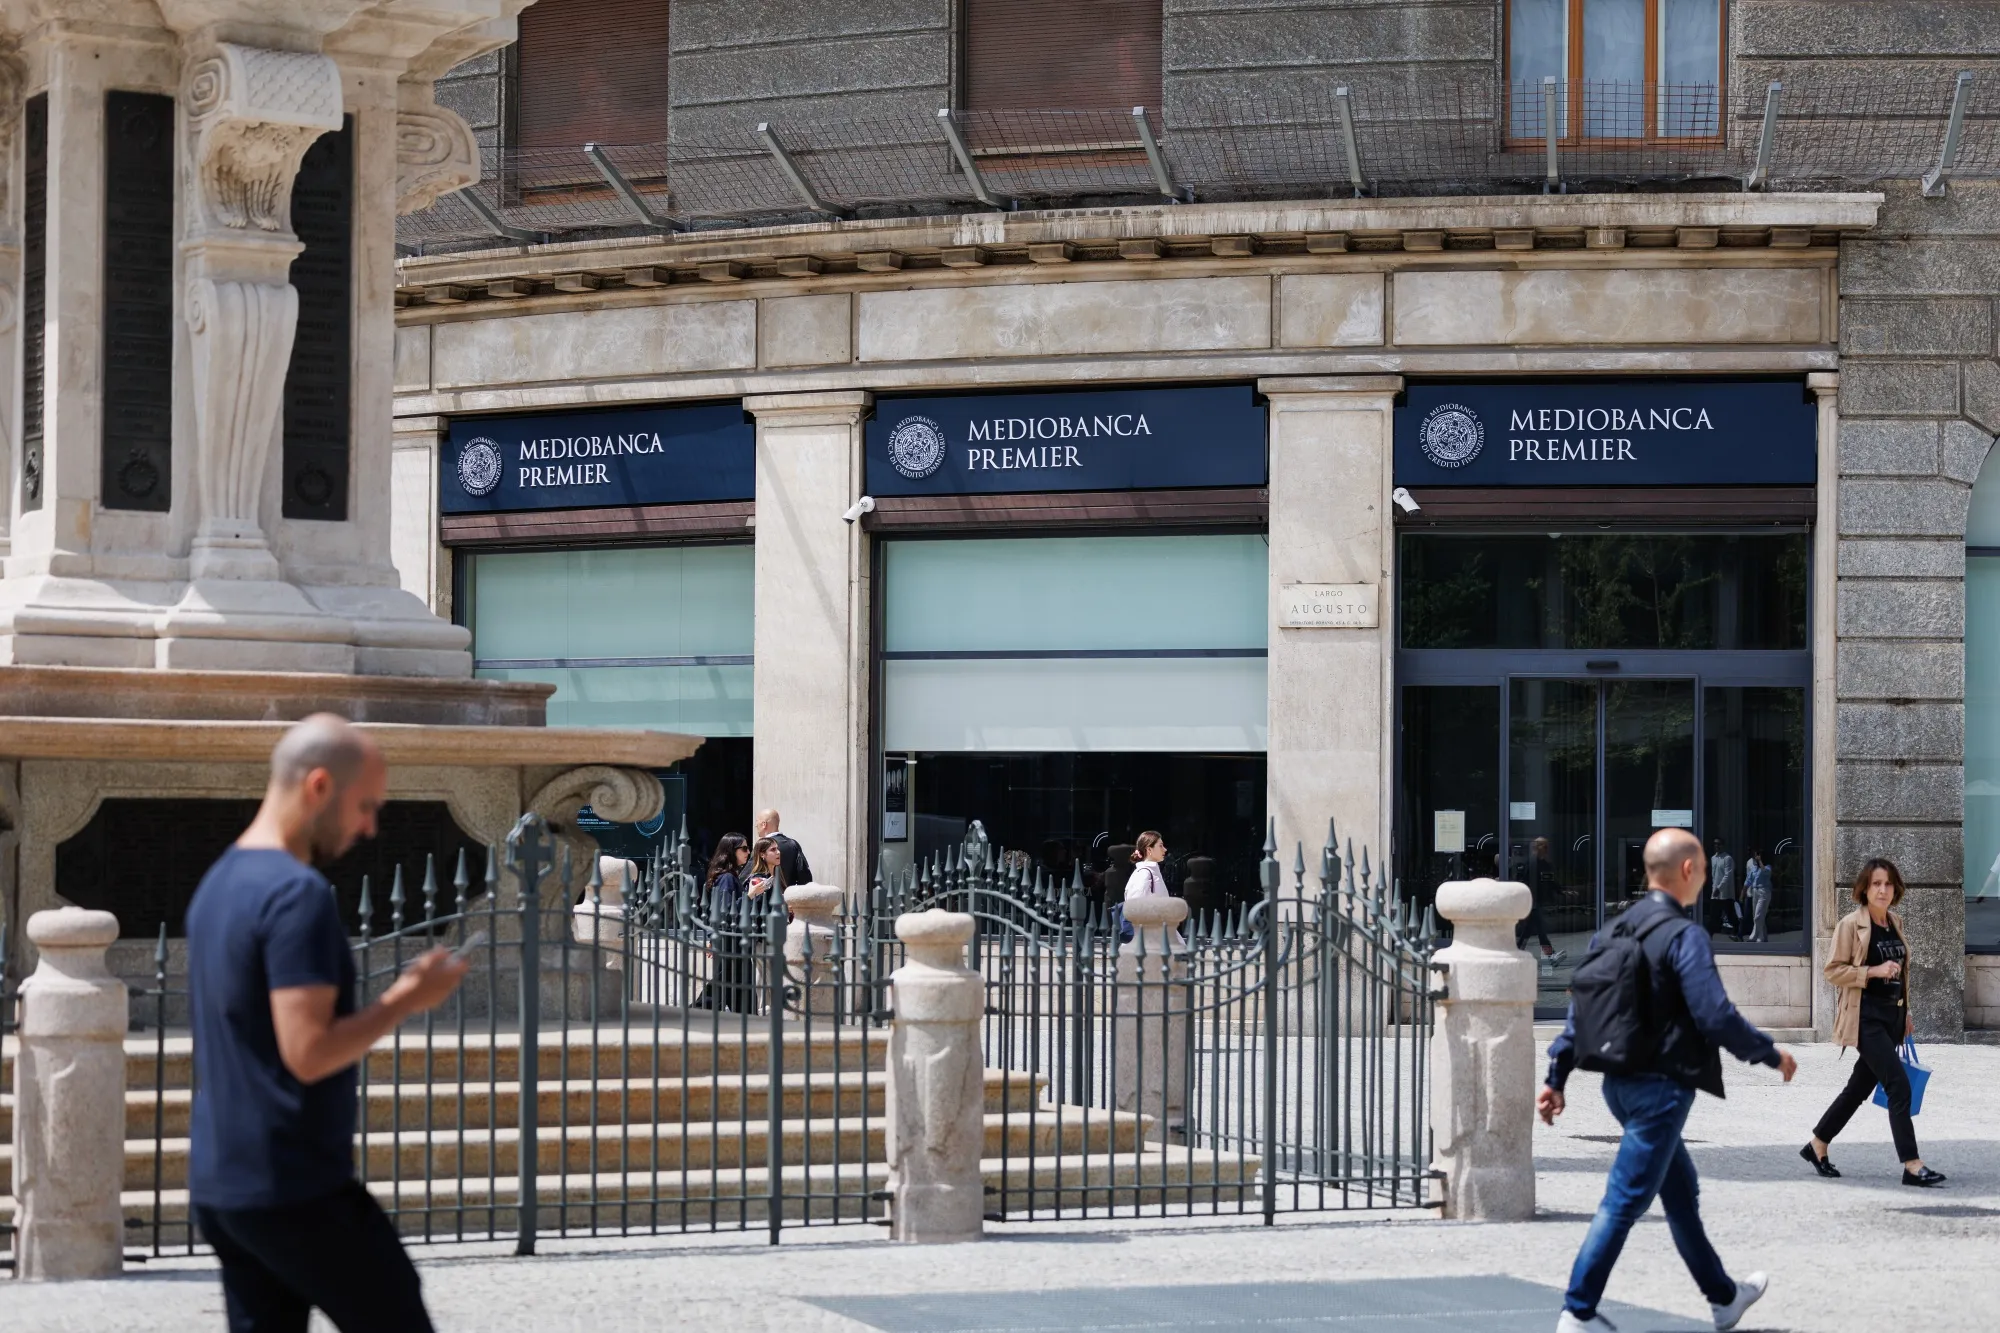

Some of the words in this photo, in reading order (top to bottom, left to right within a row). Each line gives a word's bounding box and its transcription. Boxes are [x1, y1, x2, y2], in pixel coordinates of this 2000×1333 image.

[896, 415, 939, 431] MEDIOBANCA
[1430, 403, 1478, 421] MEDIOBANCA
[1509, 407, 1714, 431] MEDIOBANCA
[967, 413, 1152, 442] MEDIOBANCA
[1419, 417, 1431, 443] BANCA
[519, 432, 665, 460] MEDIOBANCA
[888, 430, 897, 455] BANCA
[1421, 444, 1430, 453] DI
[1461, 421, 1485, 466] FINANZIARIO
[1509, 438, 1637, 461] PREMIER
[890, 456, 897, 465] DI
[967, 445, 1083, 470] PREMIER
[1427, 453, 1460, 468] CREDITO
[519, 463, 611, 488] PREMIER
[895, 464, 924, 478] CREDITO
[1291, 604, 1367, 614] AUGUSTO
